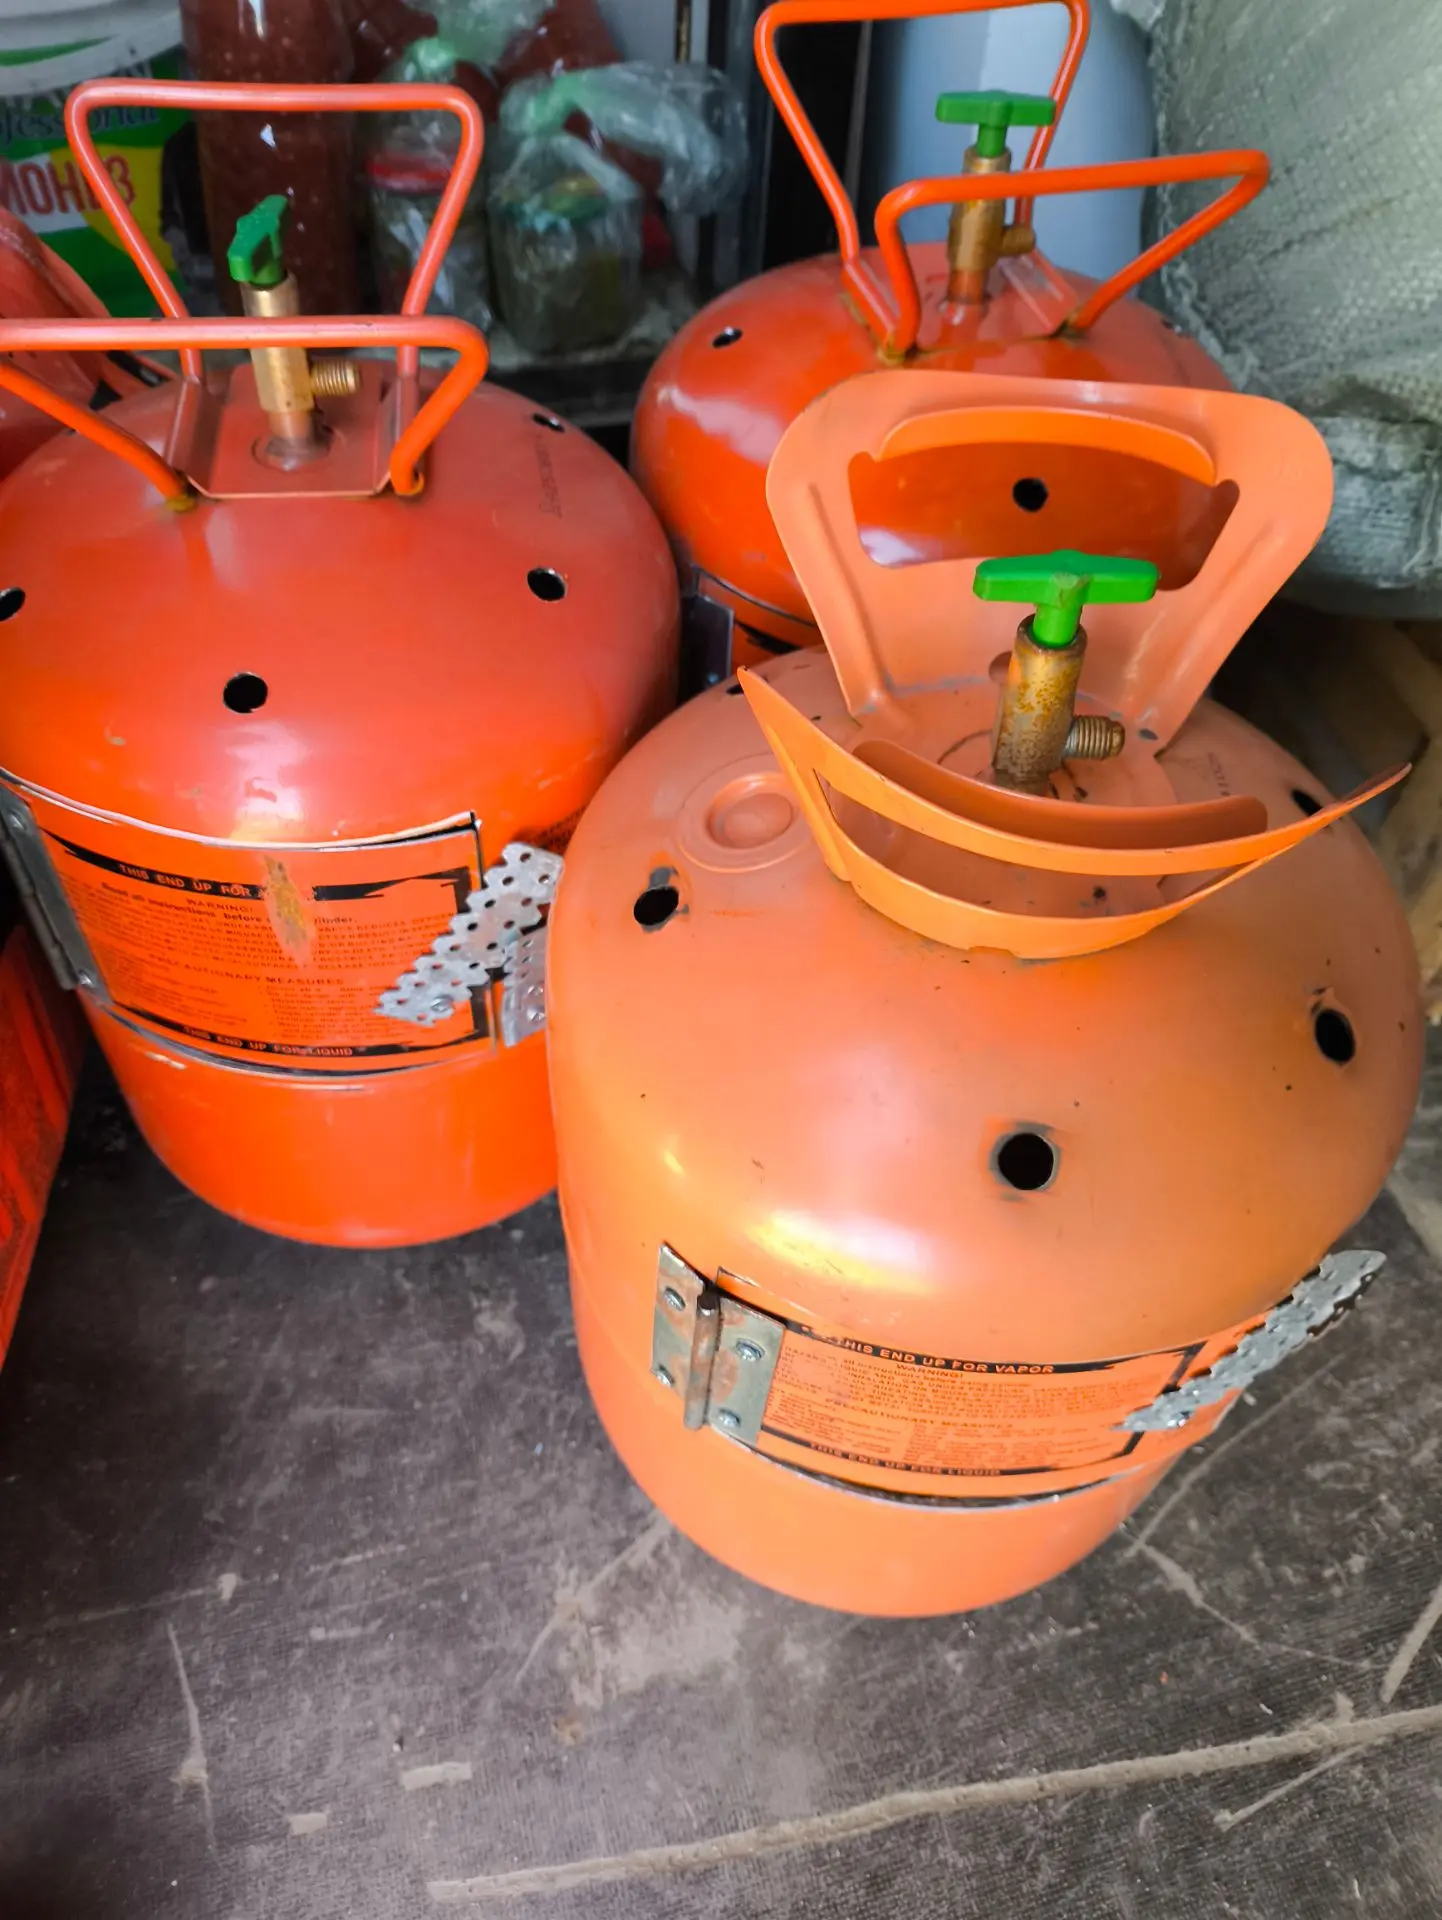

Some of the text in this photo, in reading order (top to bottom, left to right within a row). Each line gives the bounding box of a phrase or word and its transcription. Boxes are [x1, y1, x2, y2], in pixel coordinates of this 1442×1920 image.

[119, 864, 150, 880] THIS
[155, 873, 186, 888] END
[191, 879, 213, 892] UP
[220, 884, 251, 898] FOR
[216, 1034, 244, 1048] END
[249, 1041, 267, 1051] UP
[273, 1044, 301, 1056] FOR
[305, 1046, 353, 1056] LIQUID
[879, 1348, 916, 1363] END
[922, 1357, 946, 1367] UP
[952, 1360, 988, 1373] FOR
[995, 1364, 1055, 1374] VAPOR
[896, 1364, 964, 1379] WARNING!
